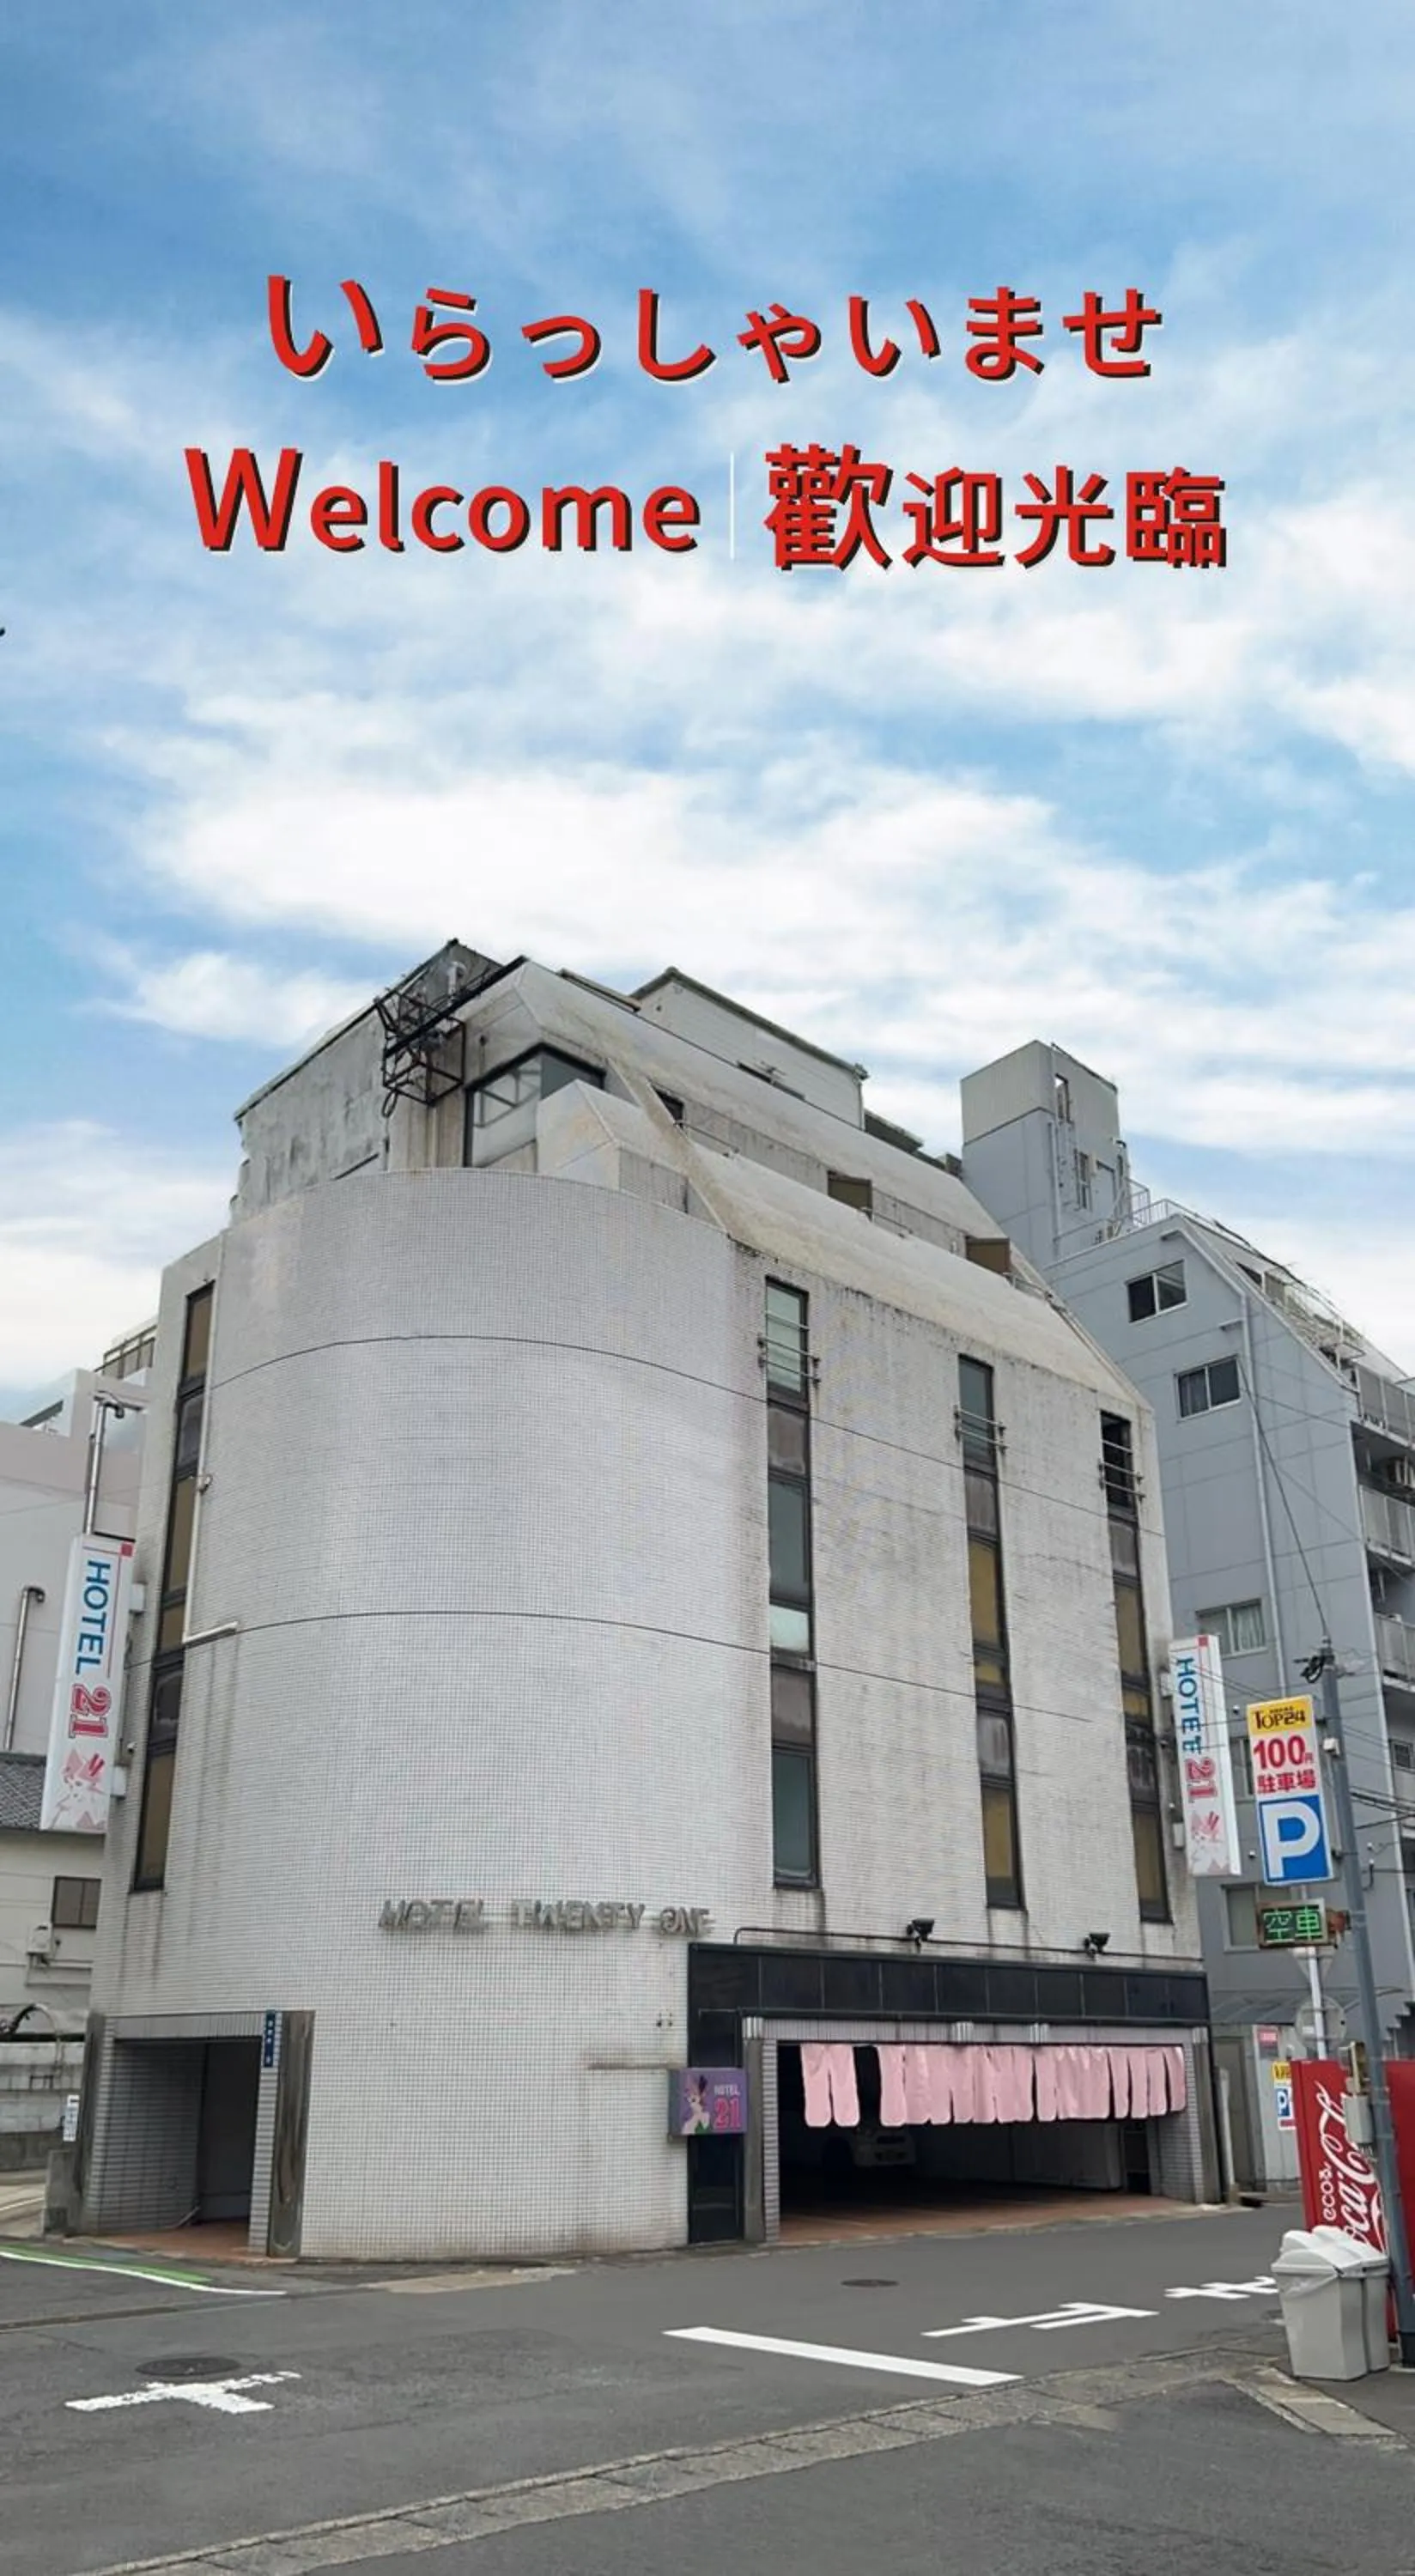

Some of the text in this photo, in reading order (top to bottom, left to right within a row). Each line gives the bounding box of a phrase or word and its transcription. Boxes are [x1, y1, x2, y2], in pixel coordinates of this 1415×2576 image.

[69, 1559, 112, 1738] HOTEL 21
[1186, 1757, 1218, 1801] 21
[1257, 1769, 1316, 1795] 駐車場
[1261, 1801, 1321, 1879] P
[1263, 1907, 1322, 1943] 空車
[713, 2095, 742, 2130] 21
